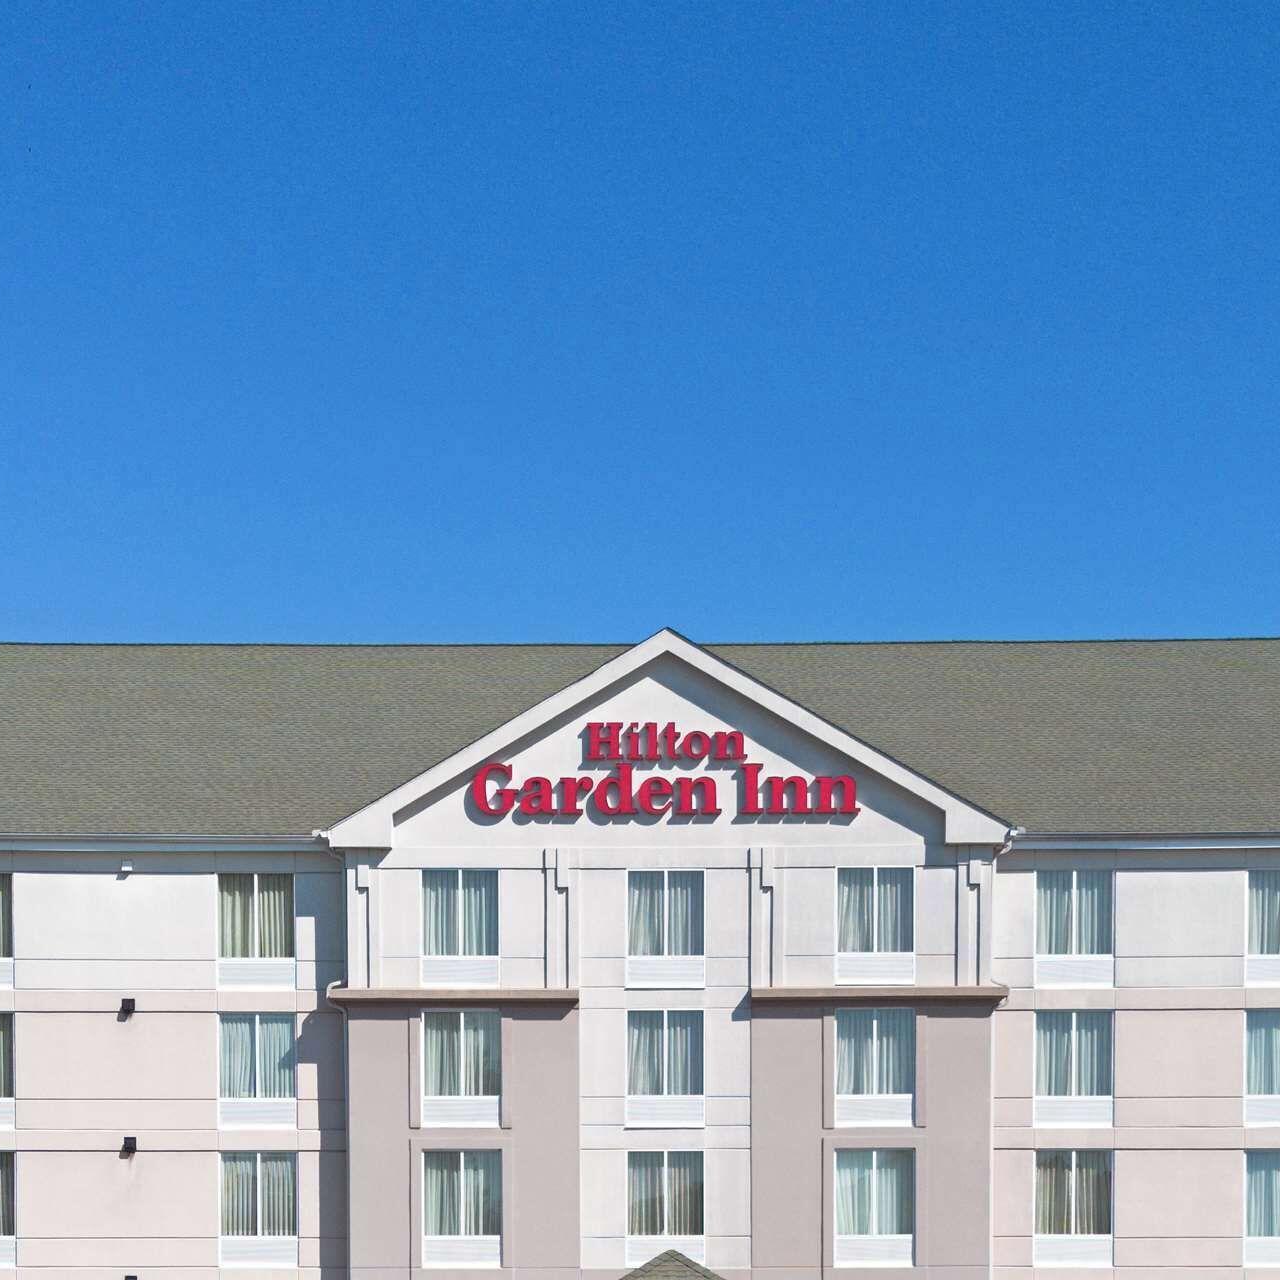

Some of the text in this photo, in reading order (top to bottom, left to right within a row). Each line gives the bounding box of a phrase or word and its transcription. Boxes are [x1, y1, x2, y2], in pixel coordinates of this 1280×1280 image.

[585, 721, 747, 762] Hilton
[471, 761, 861, 816] Garden Inn
